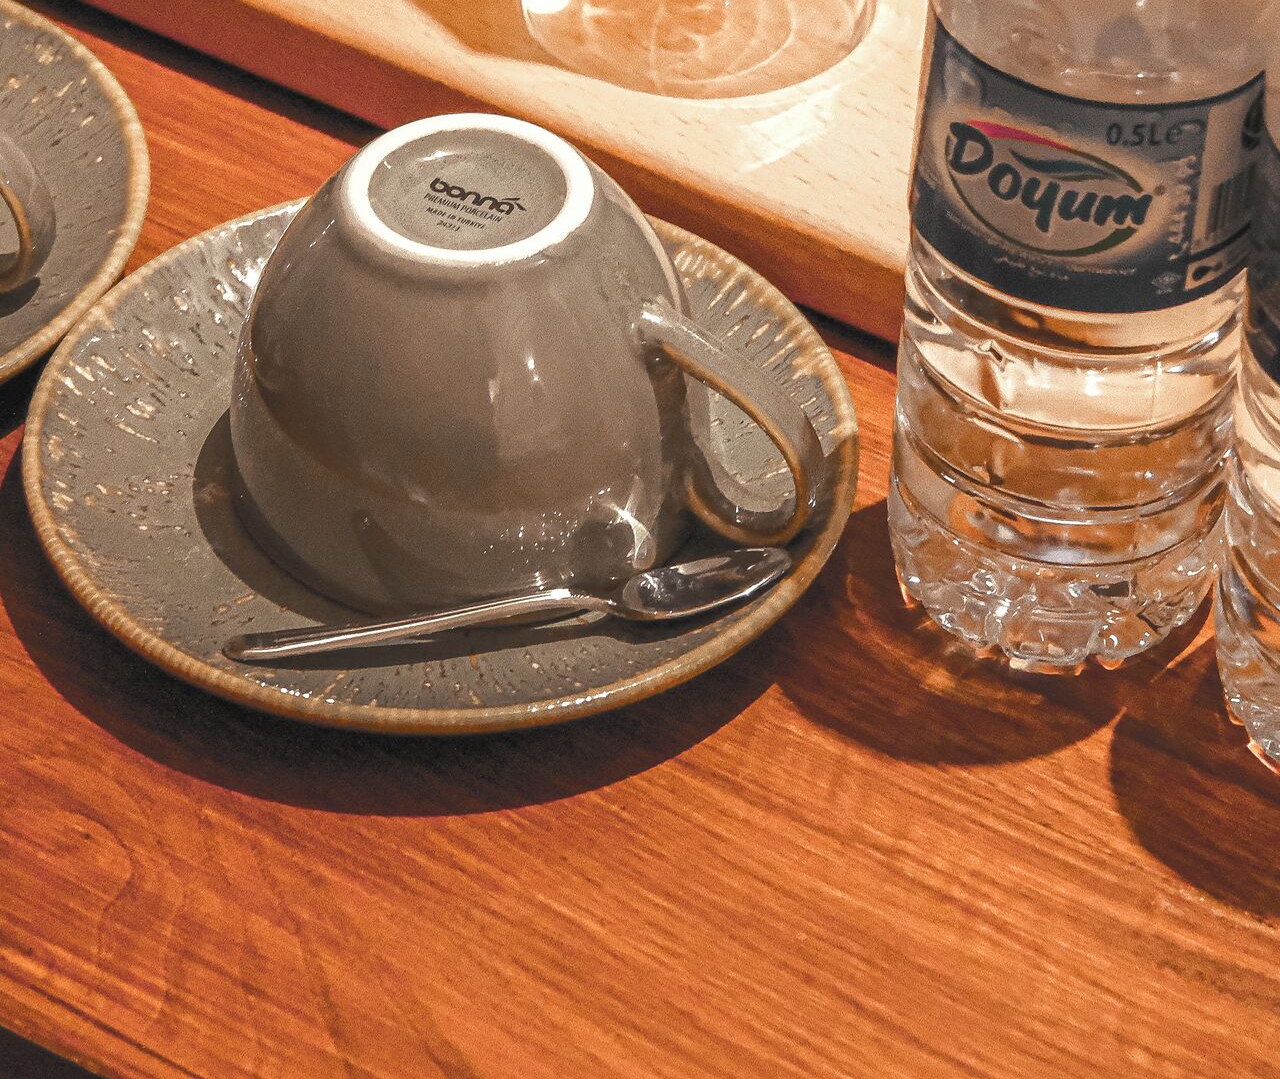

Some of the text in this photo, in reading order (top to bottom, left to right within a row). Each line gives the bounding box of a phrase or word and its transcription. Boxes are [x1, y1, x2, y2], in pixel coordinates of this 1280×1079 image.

[423, 192, 503, 223] PREMIUM PORCELAIN
[949, 121, 1154, 233] Doyum
